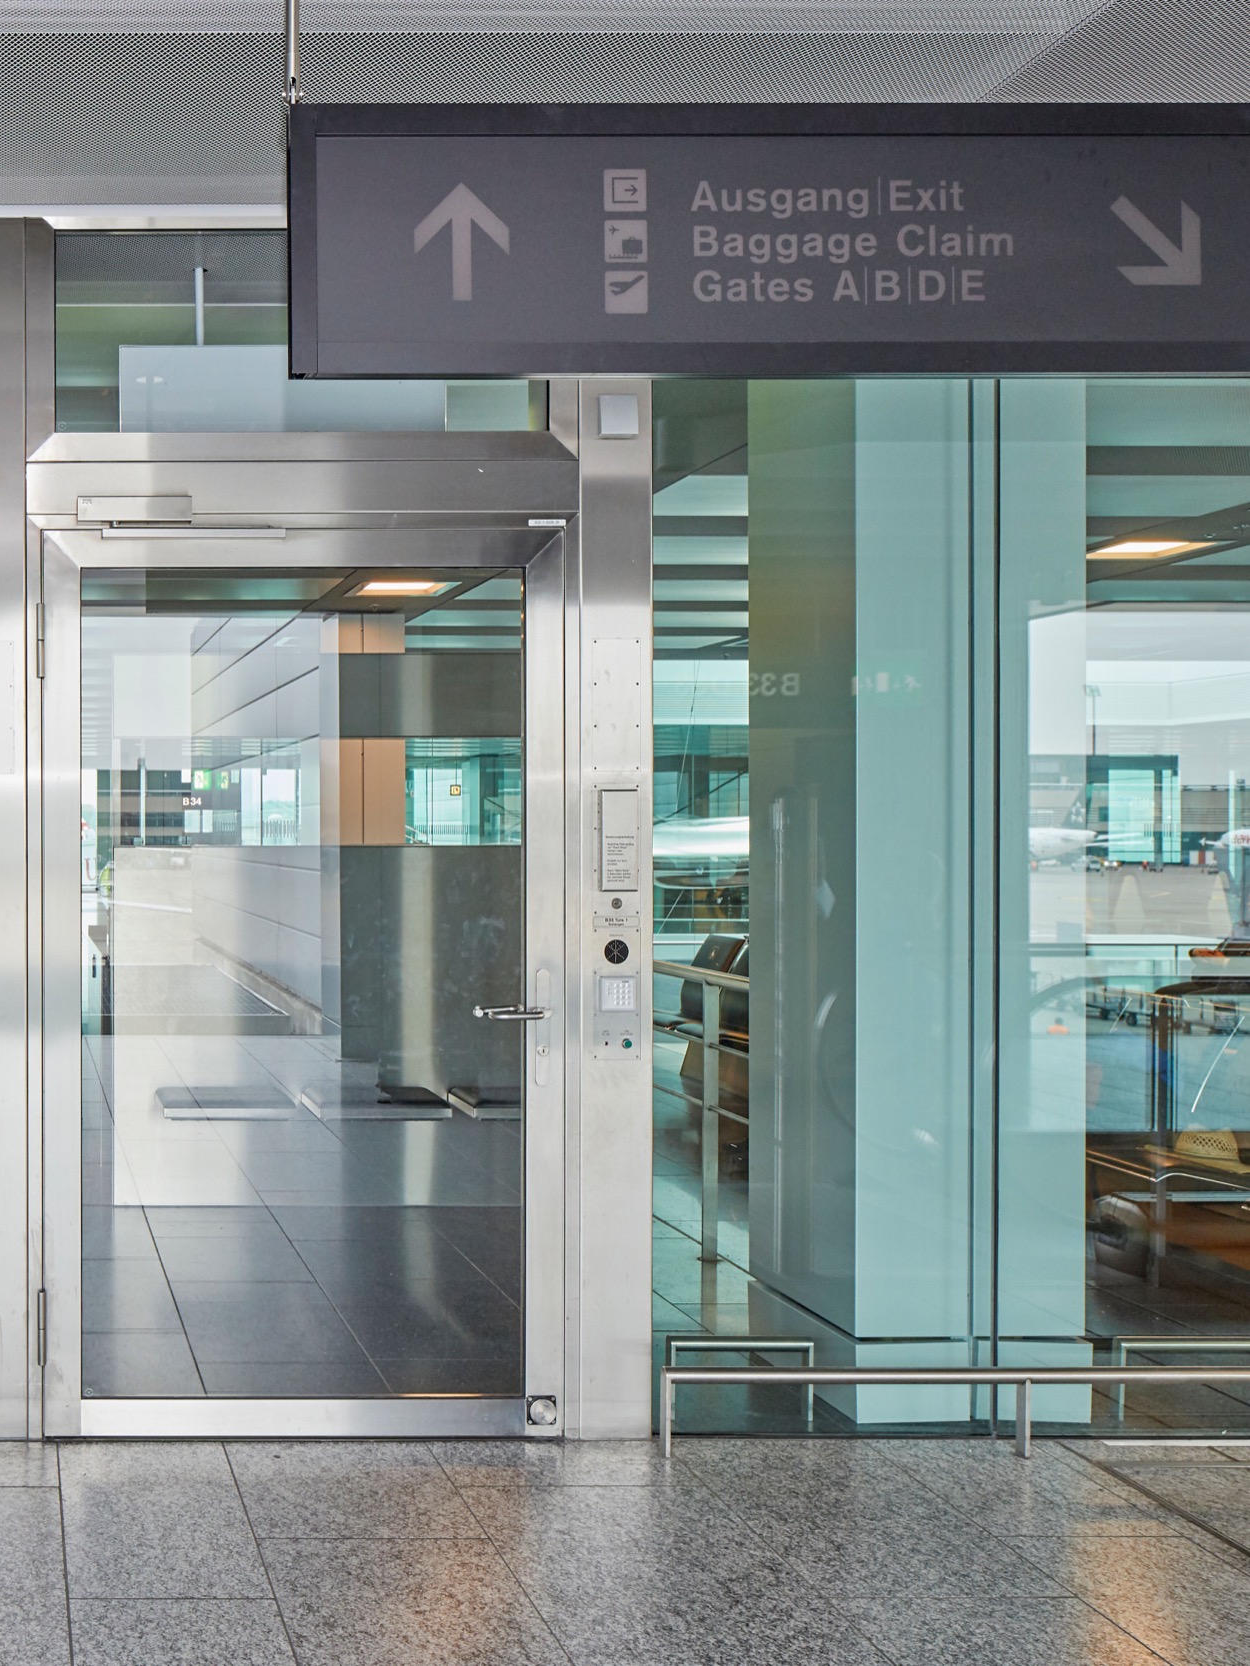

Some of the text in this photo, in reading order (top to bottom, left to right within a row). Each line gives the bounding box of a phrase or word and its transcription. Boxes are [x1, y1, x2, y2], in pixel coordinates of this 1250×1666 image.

[692, 224, 1015, 264] Baggage Claim
[692, 269, 815, 303] Gates
